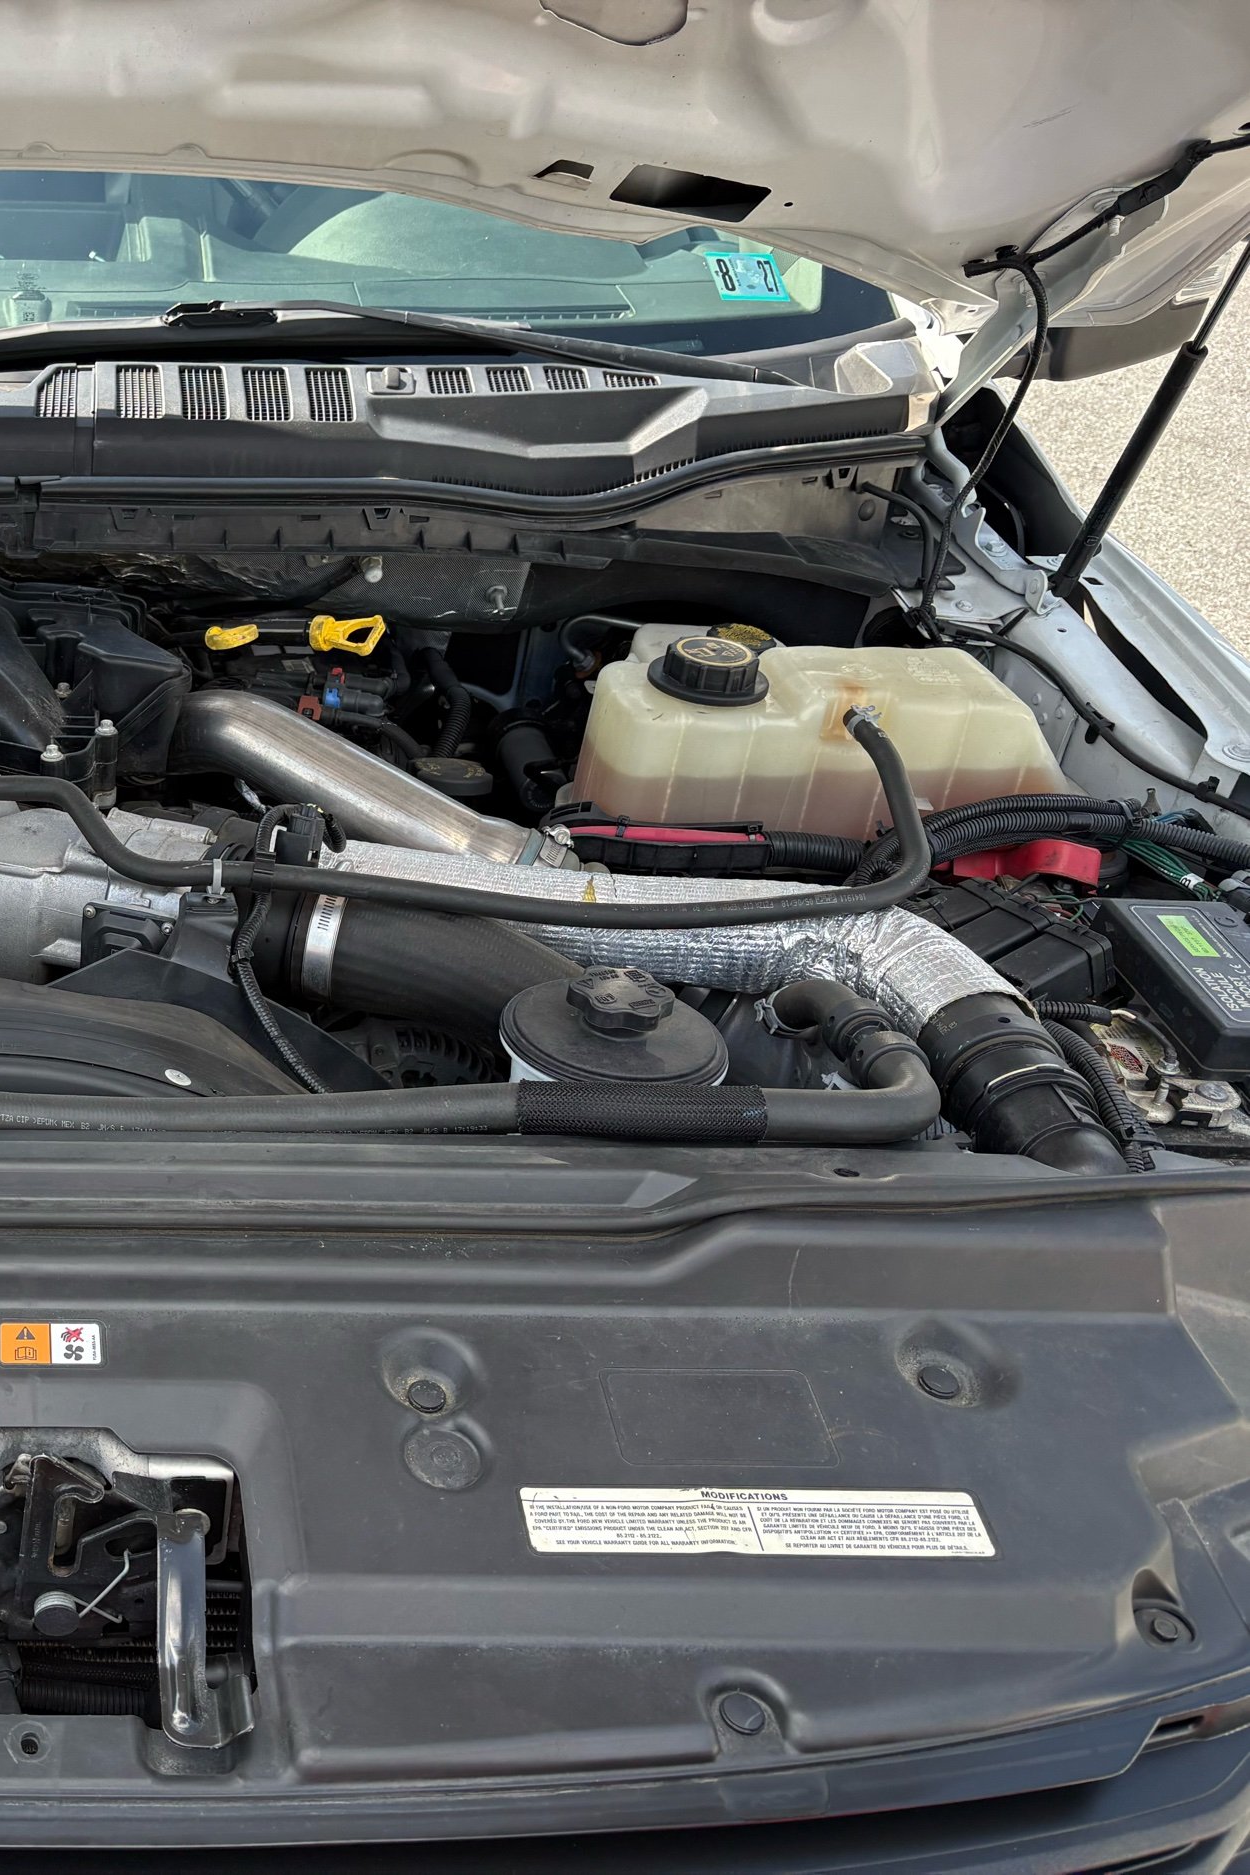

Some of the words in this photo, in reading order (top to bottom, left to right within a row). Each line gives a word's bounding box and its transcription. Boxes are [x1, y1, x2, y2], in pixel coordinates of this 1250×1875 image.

[716, 258, 736, 292] 8
[756, 260, 779, 292] 27
[1192, 968, 1242, 1011] ISOLATION
[1211, 972, 1250, 1008] MODULE
[16, 1115, 29, 1123] CIP
[61, 1119, 75, 1128] MEX
[700, 1491, 788, 1501] MODIFICATIONS
